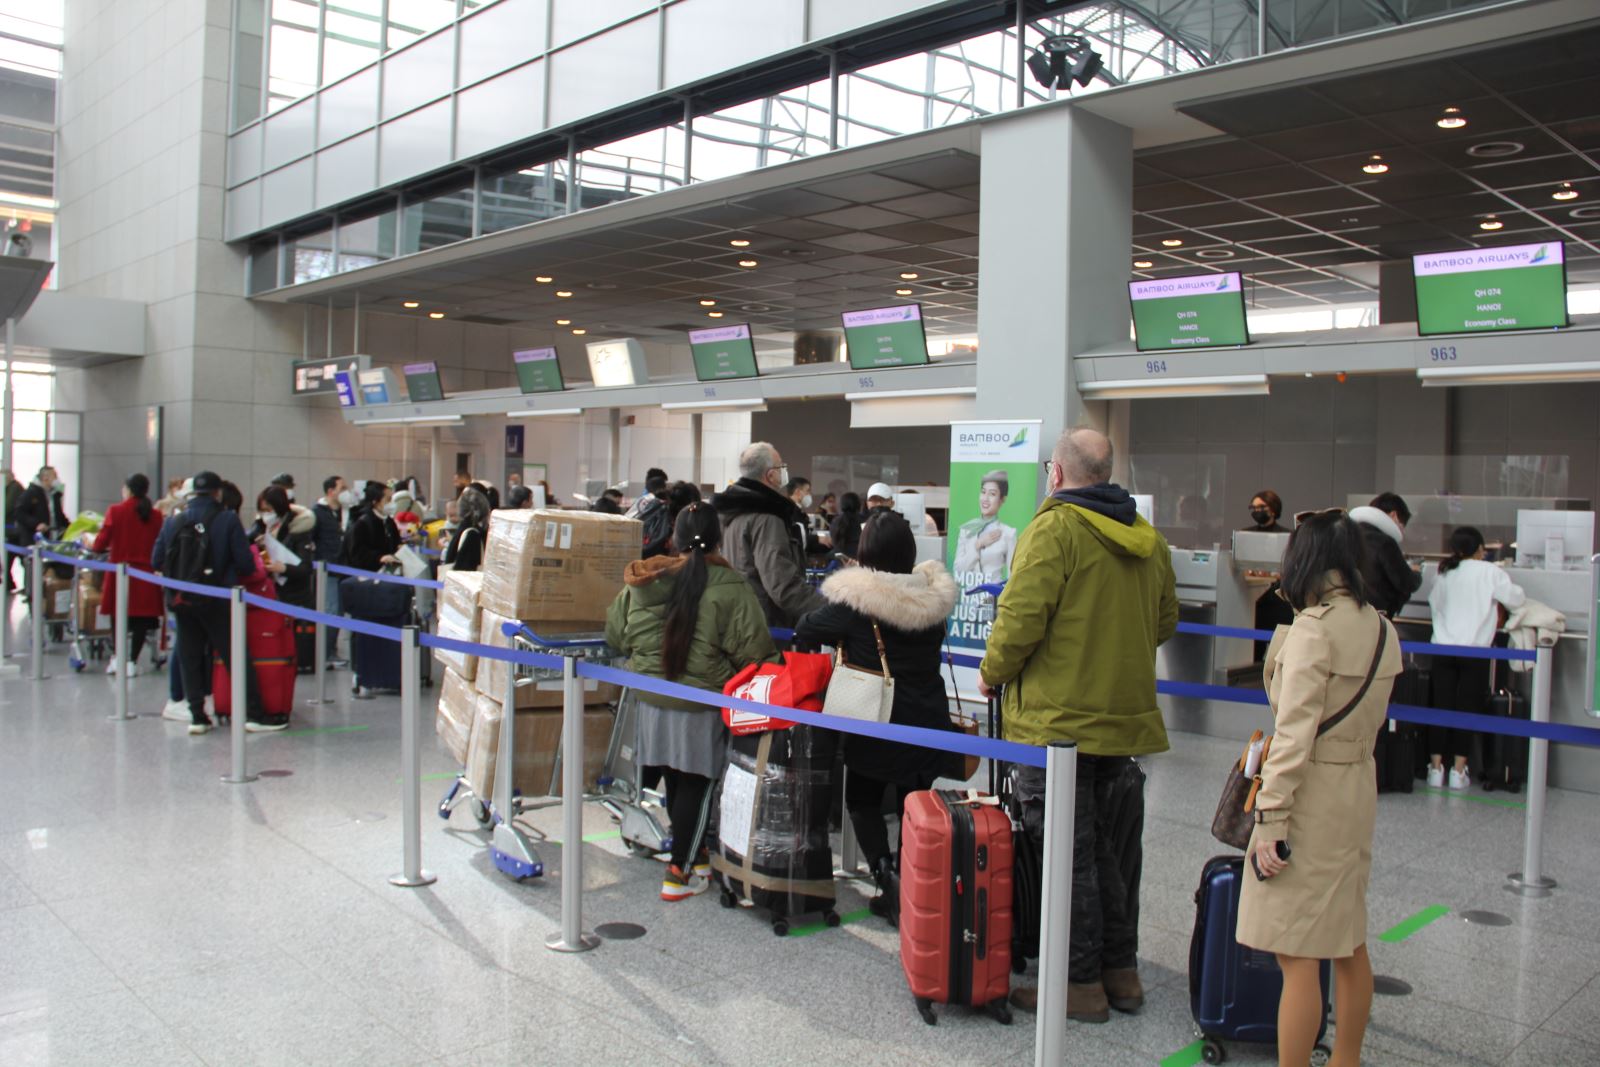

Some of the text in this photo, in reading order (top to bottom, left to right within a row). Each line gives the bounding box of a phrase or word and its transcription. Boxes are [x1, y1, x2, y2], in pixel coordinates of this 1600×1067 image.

[1423, 251, 1530, 269] BAMBOO AIRWAYS
[1137, 280, 1216, 295] BAMBOO AIRWAYS
[1474, 288, 1502, 298] QH 074
[1476, 303, 1502, 312] HANOI
[1464, 317, 1517, 328] Economy Class
[1430, 346, 1457, 361] 963
[1146, 360, 1167, 373] 964
[859, 376, 874, 388] 965
[959, 433, 1010, 442] BAMBOO
[954, 570, 992, 587] MORE
[951, 604, 985, 622] JUST
[949, 621, 962, 637] A
